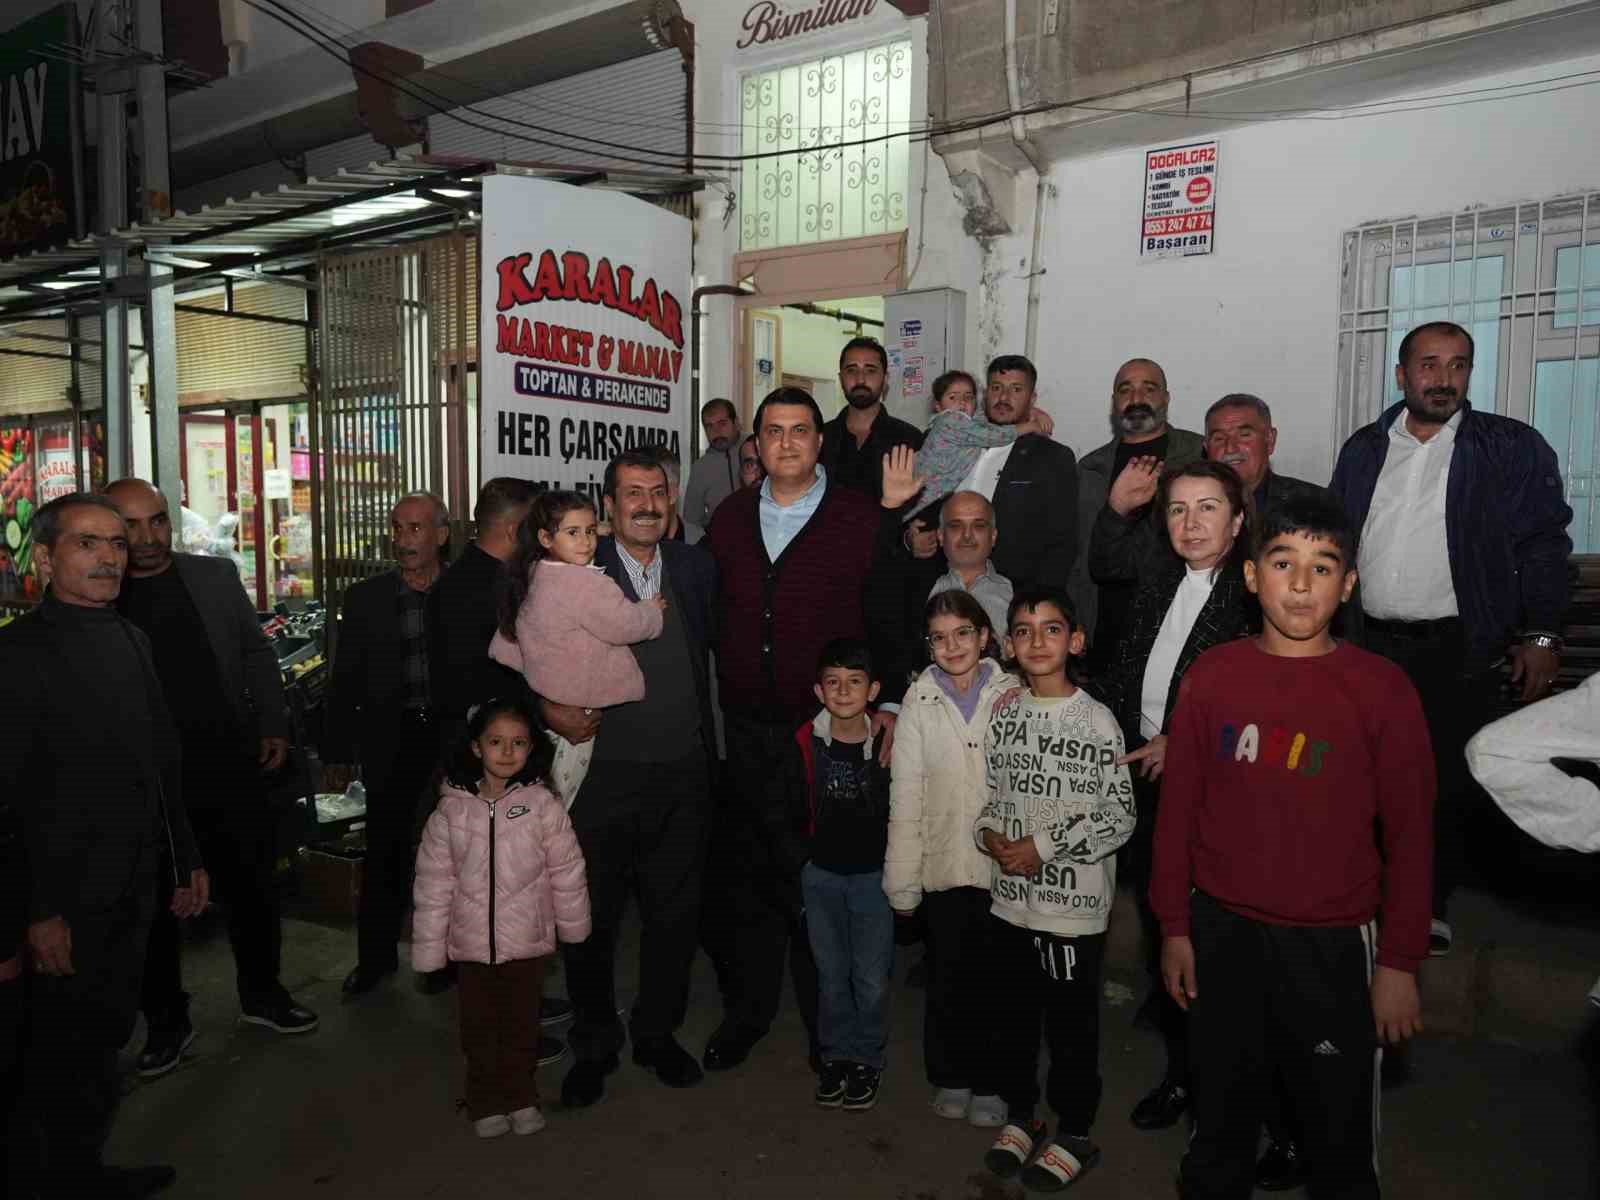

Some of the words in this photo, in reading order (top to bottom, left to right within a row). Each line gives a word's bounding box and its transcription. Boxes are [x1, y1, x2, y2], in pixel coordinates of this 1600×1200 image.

[0, 61, 48, 161] AV
[1147, 235, 1207, 250] Başaran
[1186, 214, 1199, 230] 47
[1200, 213, 1212, 229] 74
[496, 249, 685, 349] KARALAR
[496, 314, 594, 368] MARKET
[617, 338, 684, 384] MANAV
[520, 366, 578, 397] TOPTAN
[581, 378, 592, 399] &
[595, 379, 668, 409] PERAKENDE
[498, 410, 551, 457] HER
[1038, 734, 1098, 764] USPA
[1009, 770, 1063, 799] USPA
